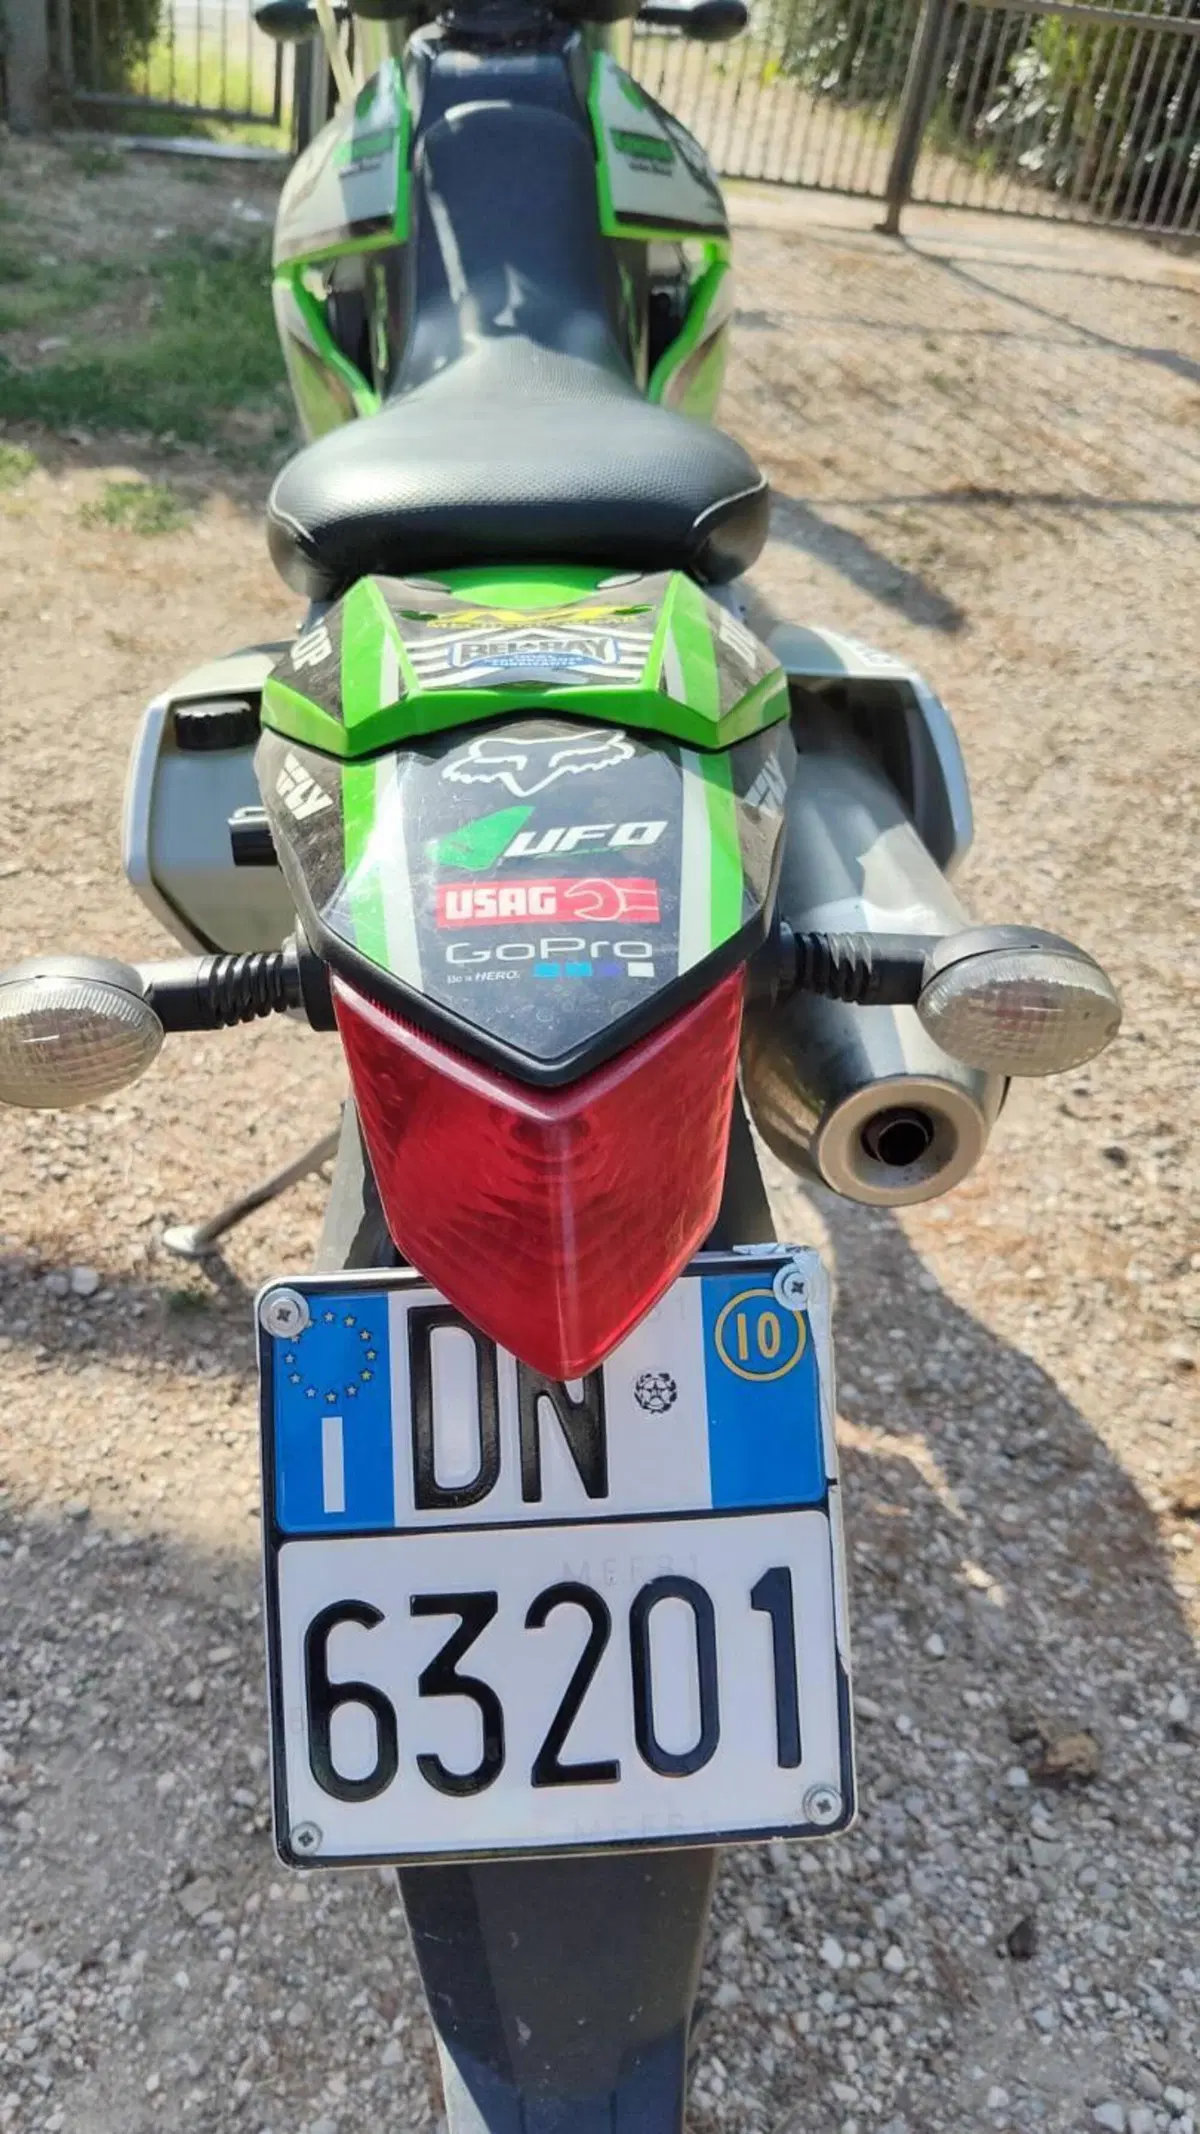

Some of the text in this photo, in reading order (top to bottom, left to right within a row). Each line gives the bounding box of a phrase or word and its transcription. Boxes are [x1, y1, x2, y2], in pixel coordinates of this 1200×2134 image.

[504, 820, 668, 857] UFO
[446, 886, 556, 920] USAG
[445, 937, 653, 964] GoPro
[737, 1311, 781, 1360] 10
[407, 1304, 608, 1510] DN
[304, 1566, 802, 1803] 63201
